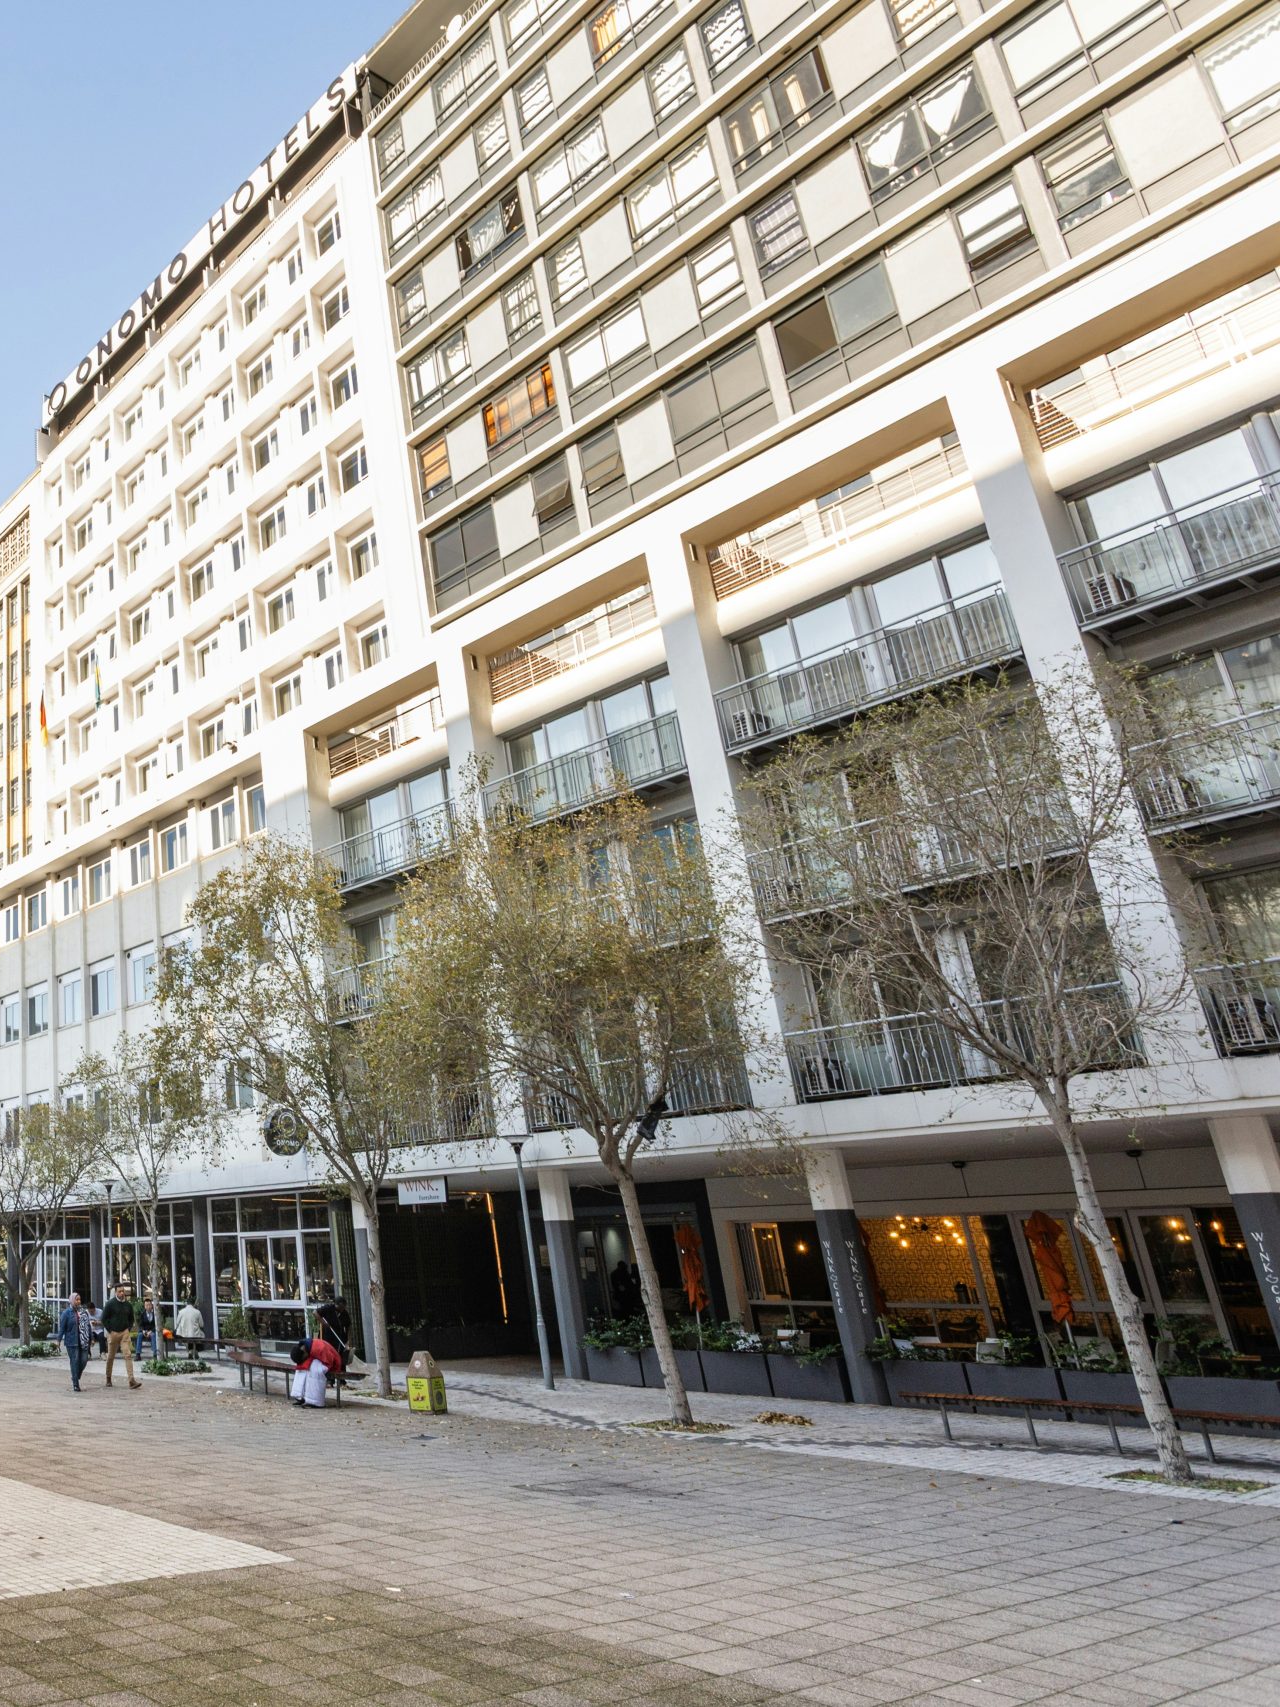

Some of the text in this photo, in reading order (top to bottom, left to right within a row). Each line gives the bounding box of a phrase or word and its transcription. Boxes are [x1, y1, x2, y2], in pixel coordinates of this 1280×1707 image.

[75, 75, 346, 385] ONOMO HOTELS
[823, 1241, 834, 1272] WINK
[845, 1241, 859, 1273] WINK
[1251, 1232, 1273, 1272] WINK
